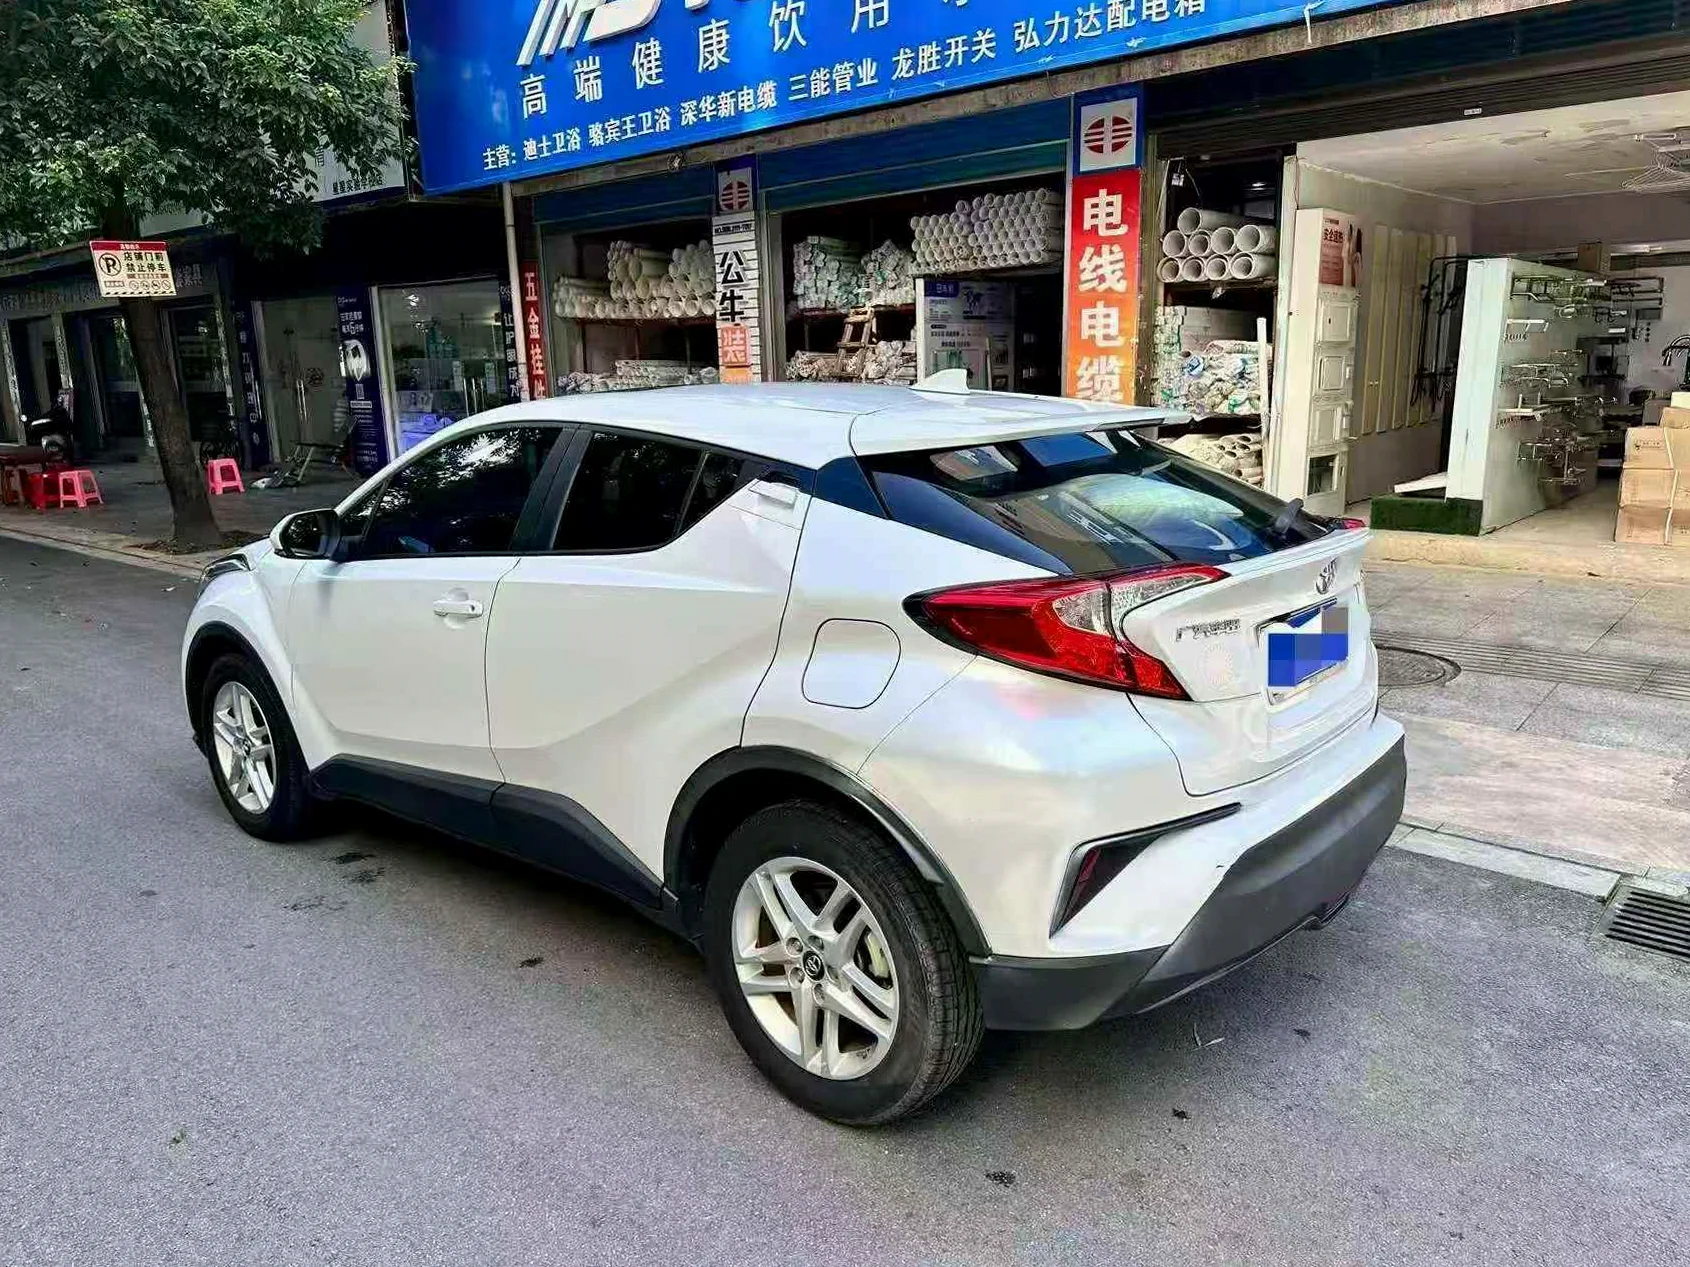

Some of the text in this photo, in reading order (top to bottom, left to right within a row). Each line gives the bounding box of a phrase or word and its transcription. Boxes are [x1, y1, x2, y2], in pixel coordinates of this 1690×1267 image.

[520, 0, 967, 119] 高端健康饮用
[523, 127, 581, 161] 迪士卫浴
[588, 108, 671, 147] 骆宾王卫浴
[680, 80, 777, 126] 深华新电缆
[788, 57, 878, 101] 三能管业
[891, 27, 997, 81] 龙胜开关
[1013, 0, 1206, 52] 弘力达配电箱
[126, 263, 167, 272] 禁止停车
